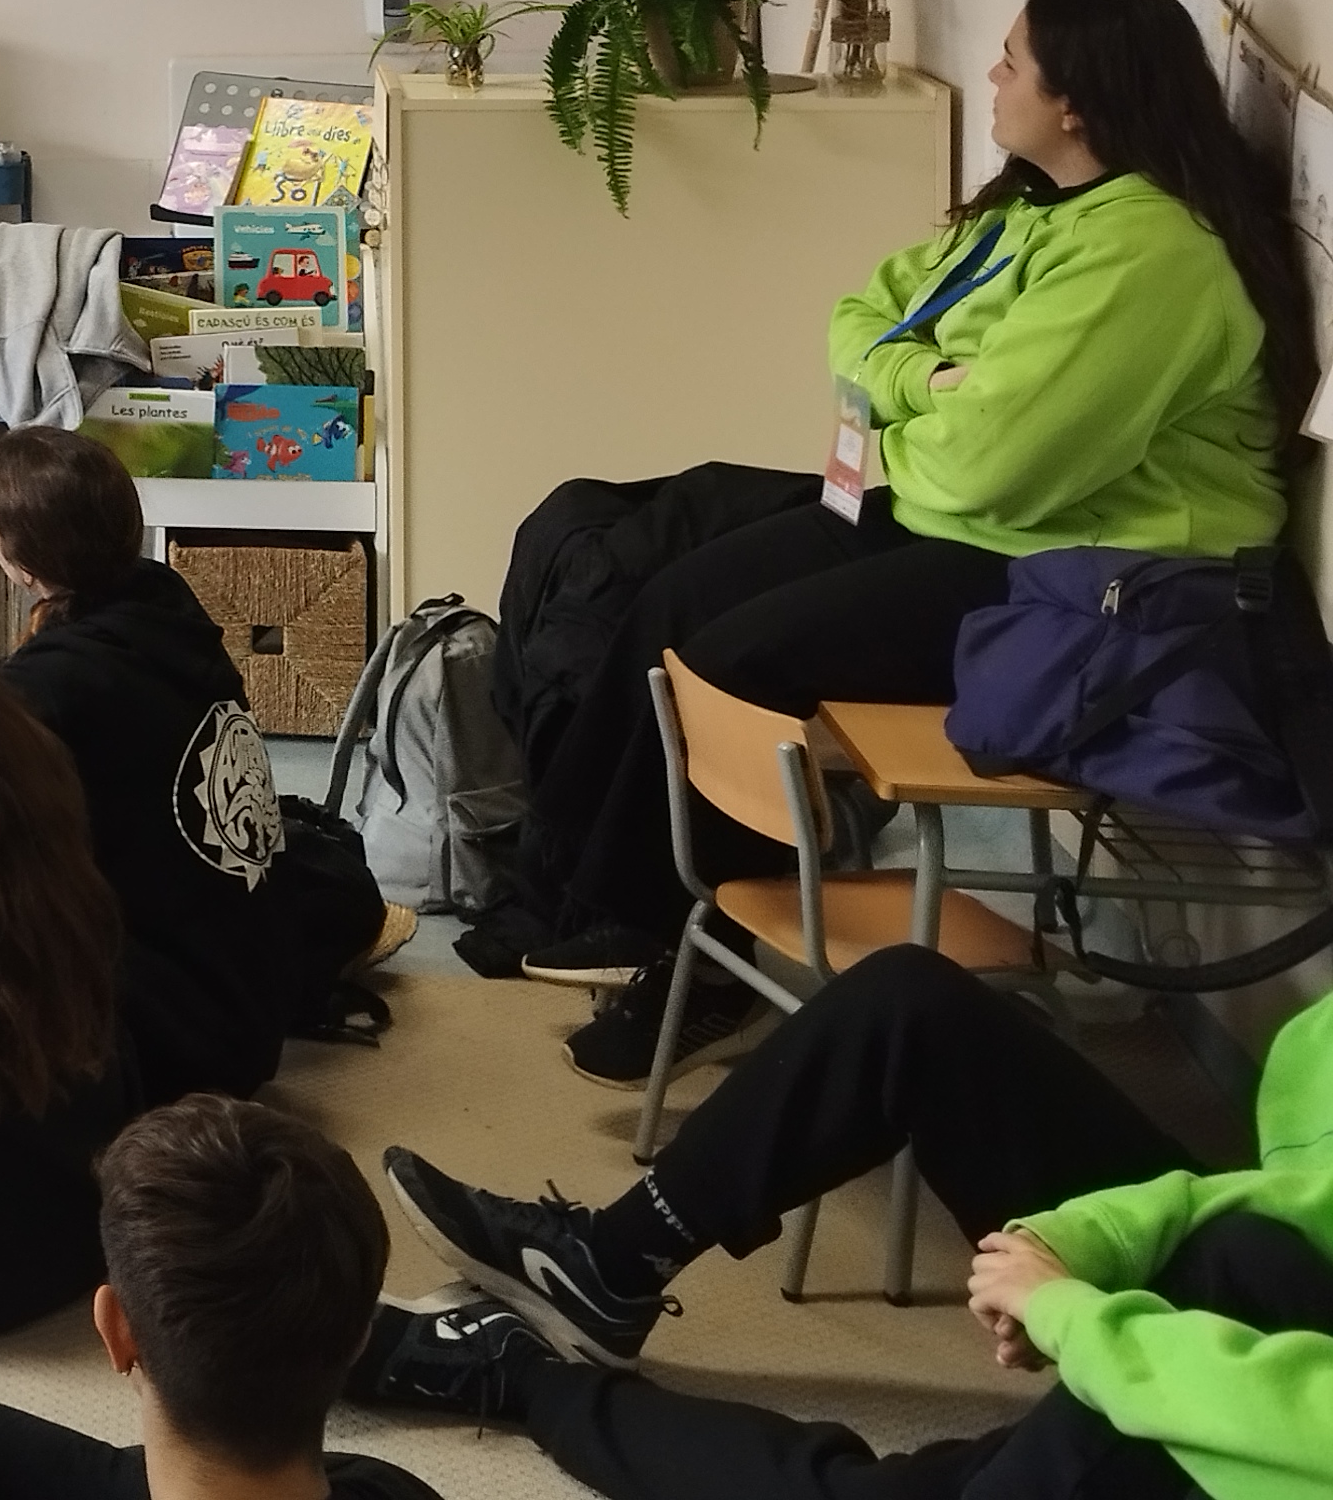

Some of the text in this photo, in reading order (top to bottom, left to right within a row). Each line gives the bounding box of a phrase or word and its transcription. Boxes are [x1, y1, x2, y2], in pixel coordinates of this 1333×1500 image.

[323, 125, 352, 142] dies
[197, 312, 316, 328] CADASCÚ ÉS COM ÉS
[111, 404, 188, 419] Les plantes
